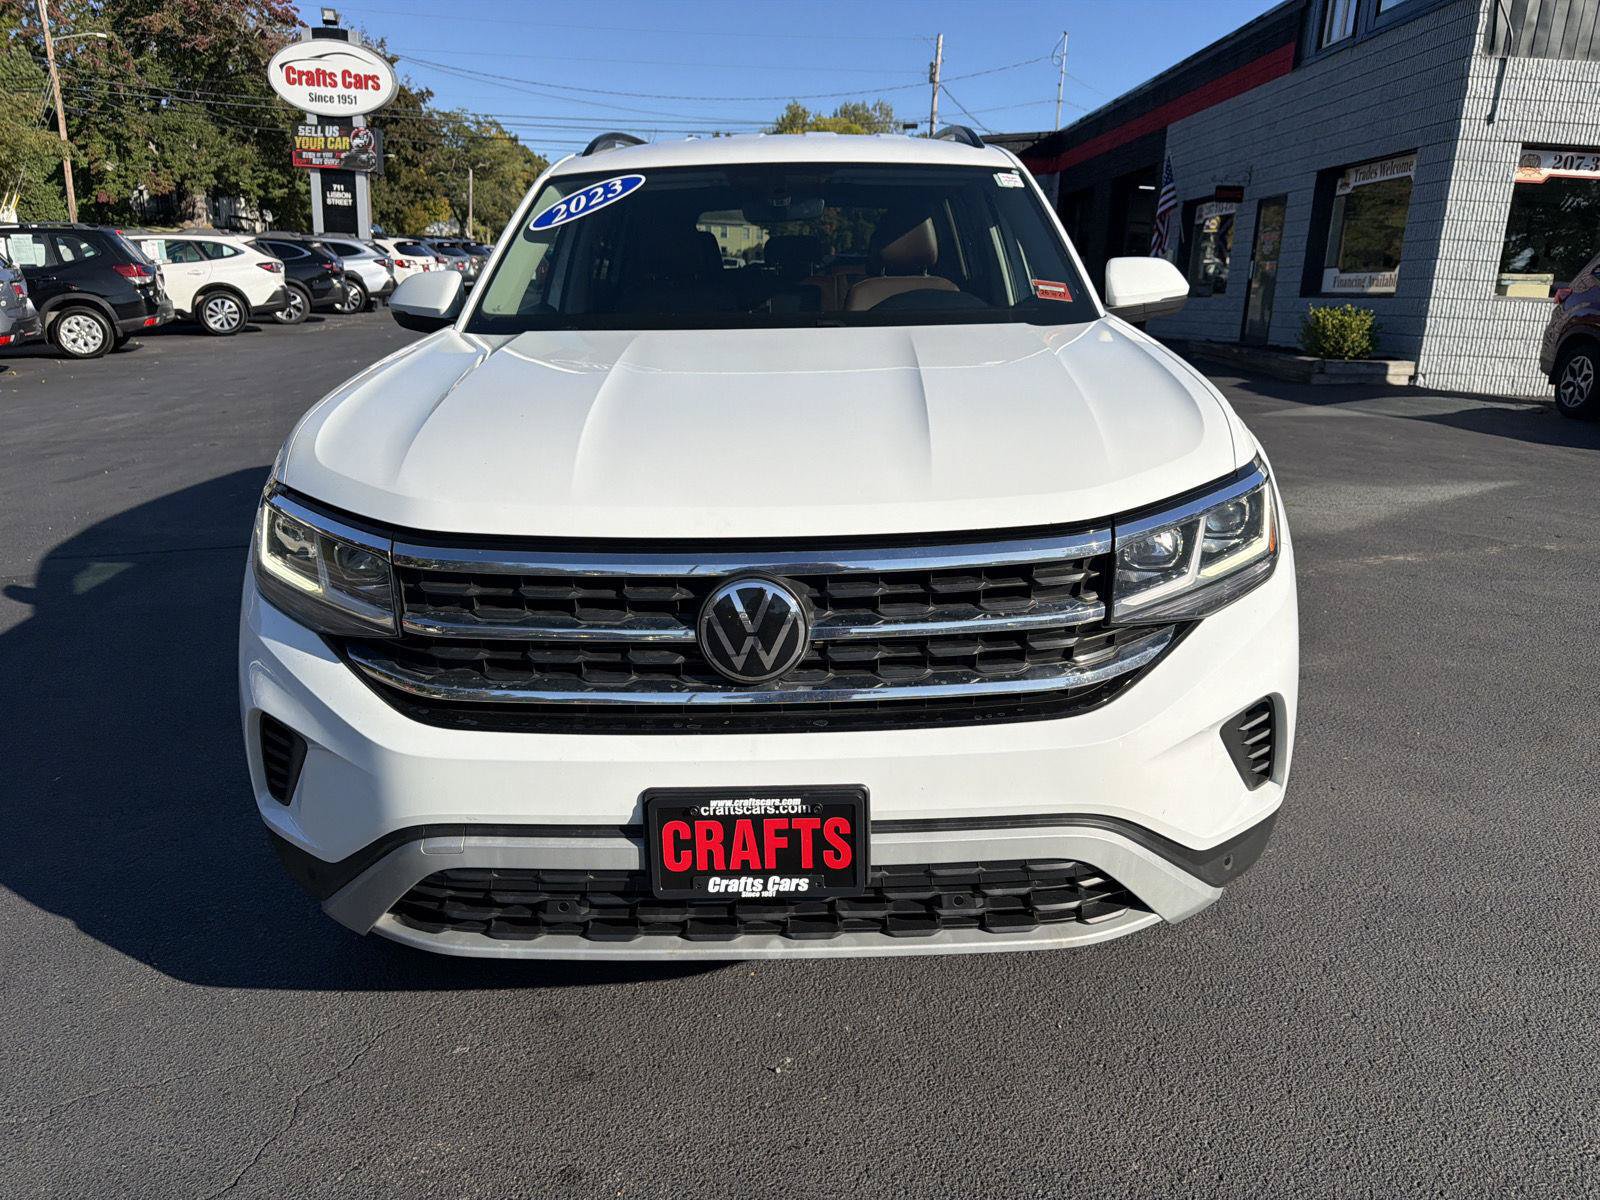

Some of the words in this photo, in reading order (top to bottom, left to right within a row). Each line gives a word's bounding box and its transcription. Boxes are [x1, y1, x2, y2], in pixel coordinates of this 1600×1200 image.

[285, 65, 337, 88] Crafts
[341, 69, 381, 91] Cars
[308, 92, 335, 104] Since
[337, 94, 358, 105] 1951
[297, 125, 324, 136] SELL
[325, 125, 340, 137] US
[294, 136, 325, 150] YOUR
[327, 137, 350, 150] CAR
[1354, 165, 1378, 182] Trades
[1380, 160, 1414, 177] Welcome
[332, 183, 345, 191] 711
[326, 191, 352, 200] LISBON
[551, 179, 623, 225] 2023
[709, 797, 802, 808] www.craftscars.com
[700, 803, 812, 817] craftscars.com
[661, 816, 853, 873] CRAFTS
[707, 875, 764, 894] Crafts
[766, 875, 810, 892] Cars
[761, 890, 777, 898] 1951
